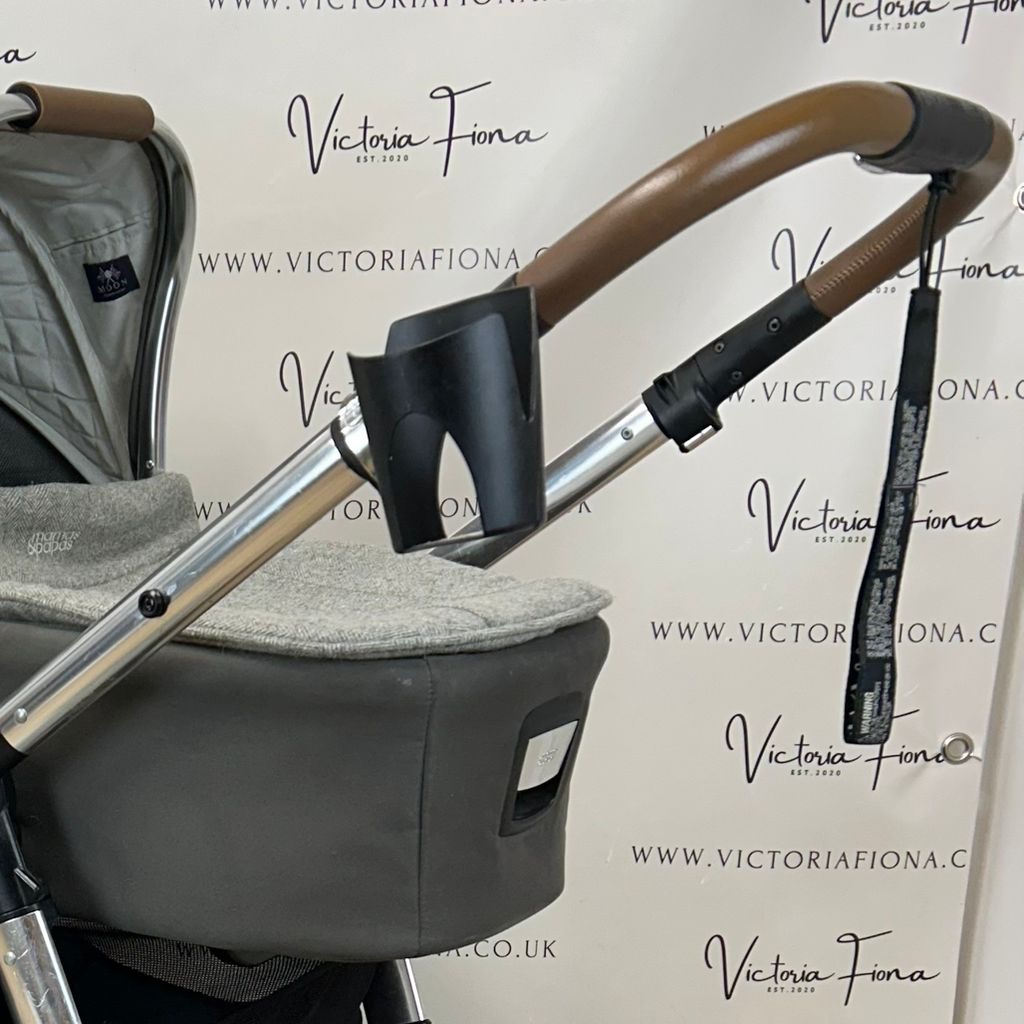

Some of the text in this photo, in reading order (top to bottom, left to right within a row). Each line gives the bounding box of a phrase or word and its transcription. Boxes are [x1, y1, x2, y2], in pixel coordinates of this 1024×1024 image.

[869, 21, 926, 31] EST.2020
[287, 81, 549, 177] Victoria Fiona
[356, 154, 409, 163] EST.2020
[198, 247, 549, 273] WWW.VICTORIAFIONA
[747, 478, 876, 552] Victoria
[911, 471, 1001, 530] iona
[860, 692, 874, 733] WARNING
[725, 713, 862, 784] Victoria
[631, 846, 968, 871] WWW.VICTORIAFIONA.C
[704, 930, 941, 1006] Victoria Fiona
